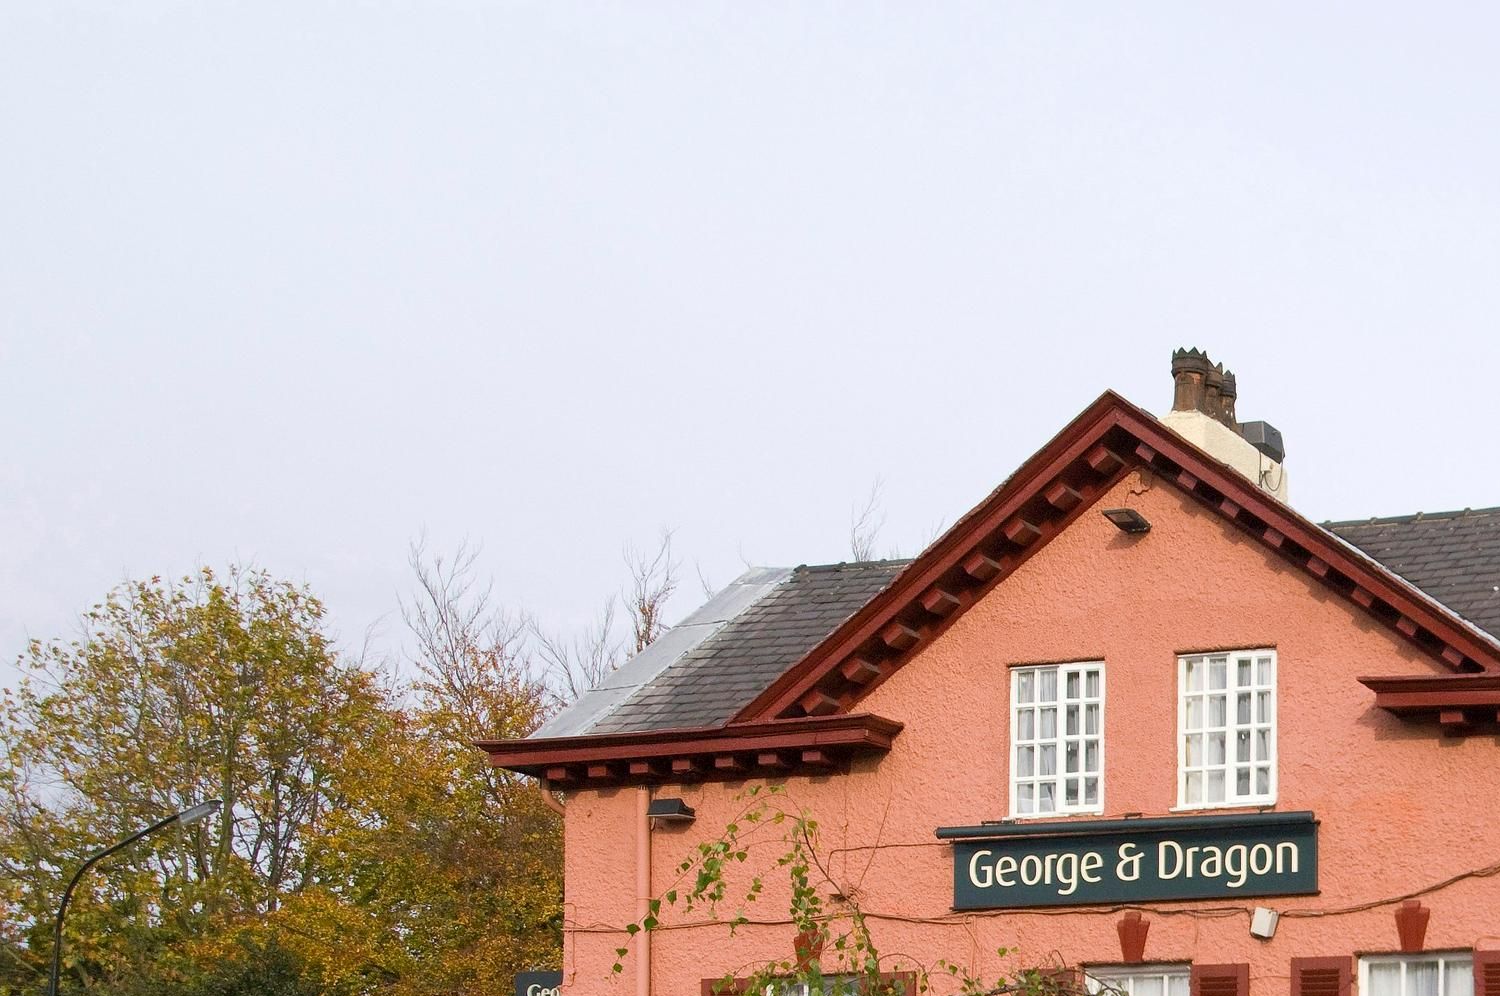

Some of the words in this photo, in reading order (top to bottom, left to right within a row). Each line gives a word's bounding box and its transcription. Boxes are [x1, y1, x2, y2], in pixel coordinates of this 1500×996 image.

[970, 851, 1103, 895] George
[1116, 843, 1144, 881] &
[1159, 841, 1298, 887] Dragon
